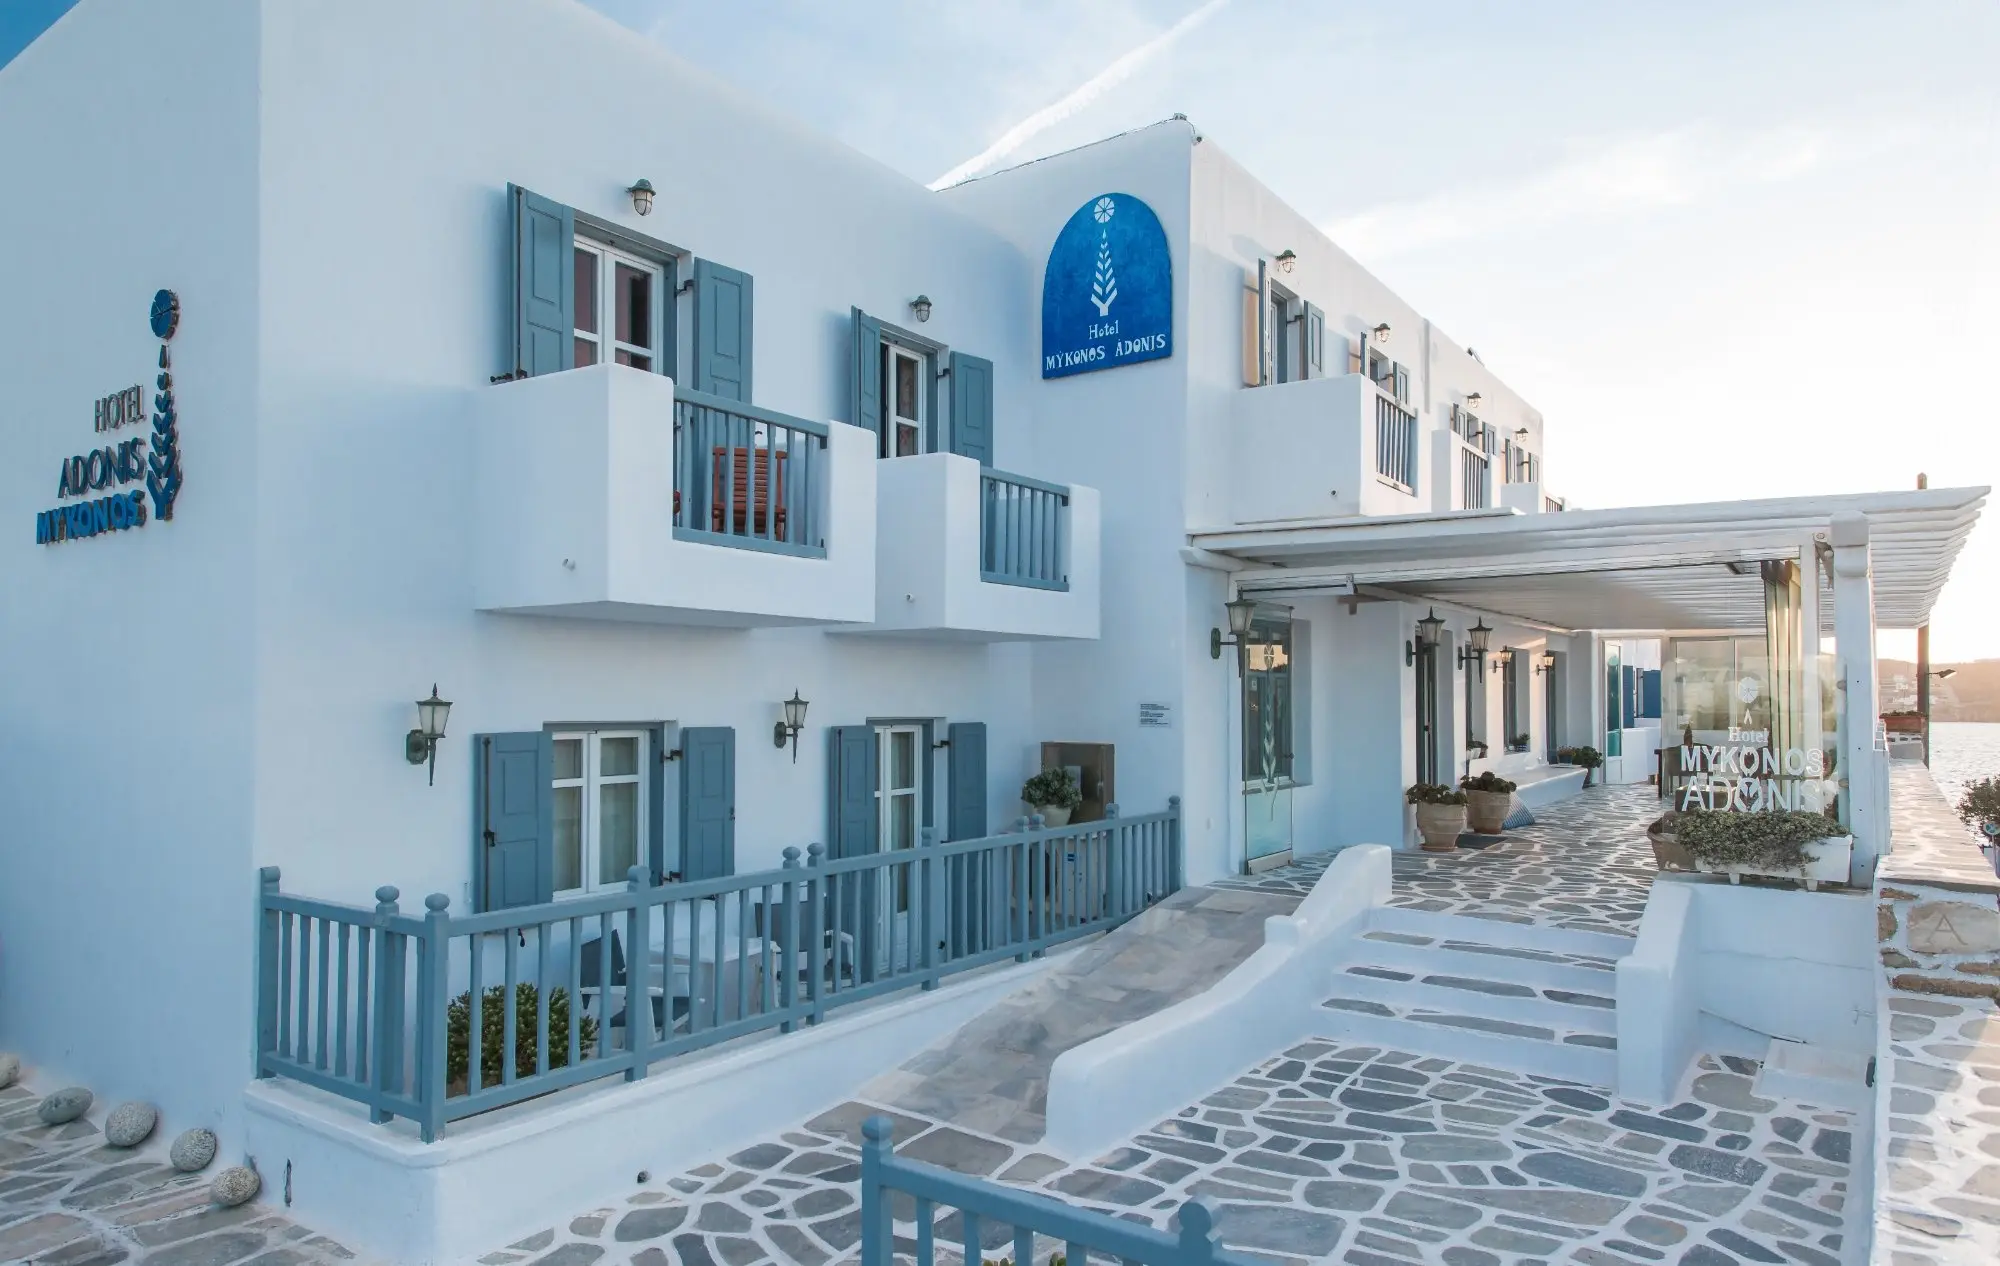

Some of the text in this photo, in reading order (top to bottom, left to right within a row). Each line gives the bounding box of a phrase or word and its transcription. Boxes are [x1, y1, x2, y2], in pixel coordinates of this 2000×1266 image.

[1089, 319, 1119, 340] Hotel
[1046, 333, 1166, 370] MYKONOS ADONIS
[94, 384, 146, 433] HOTEL
[58, 437, 147, 499] ADONIS
[36, 489, 147, 545] MYKONOS
[1728, 726, 1769, 743] Hotel
[1681, 745, 1824, 776] MYKONOS
